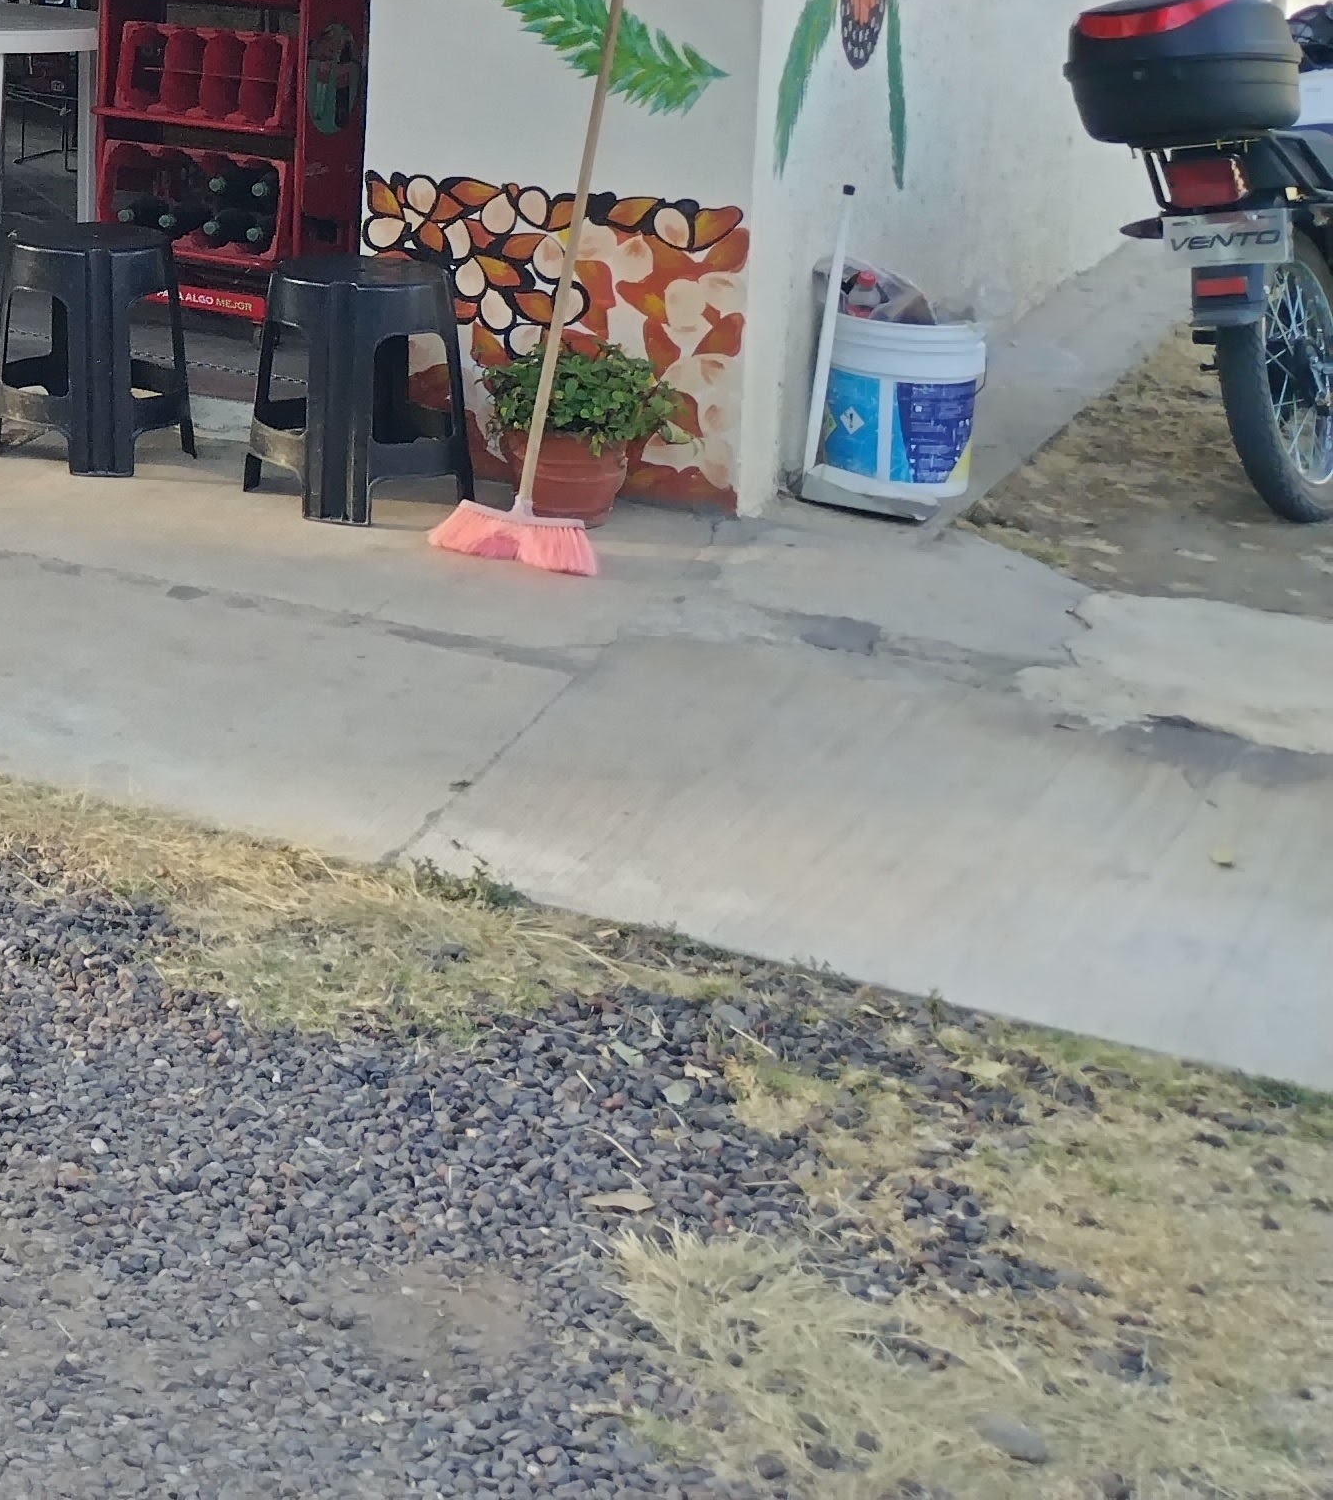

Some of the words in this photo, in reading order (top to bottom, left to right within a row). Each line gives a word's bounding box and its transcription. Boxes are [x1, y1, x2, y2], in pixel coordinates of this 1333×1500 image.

[1170, 229, 1282, 252] VENTO
[185, 292, 214, 305] ALGO
[215, 298, 253, 312] MEJOR
